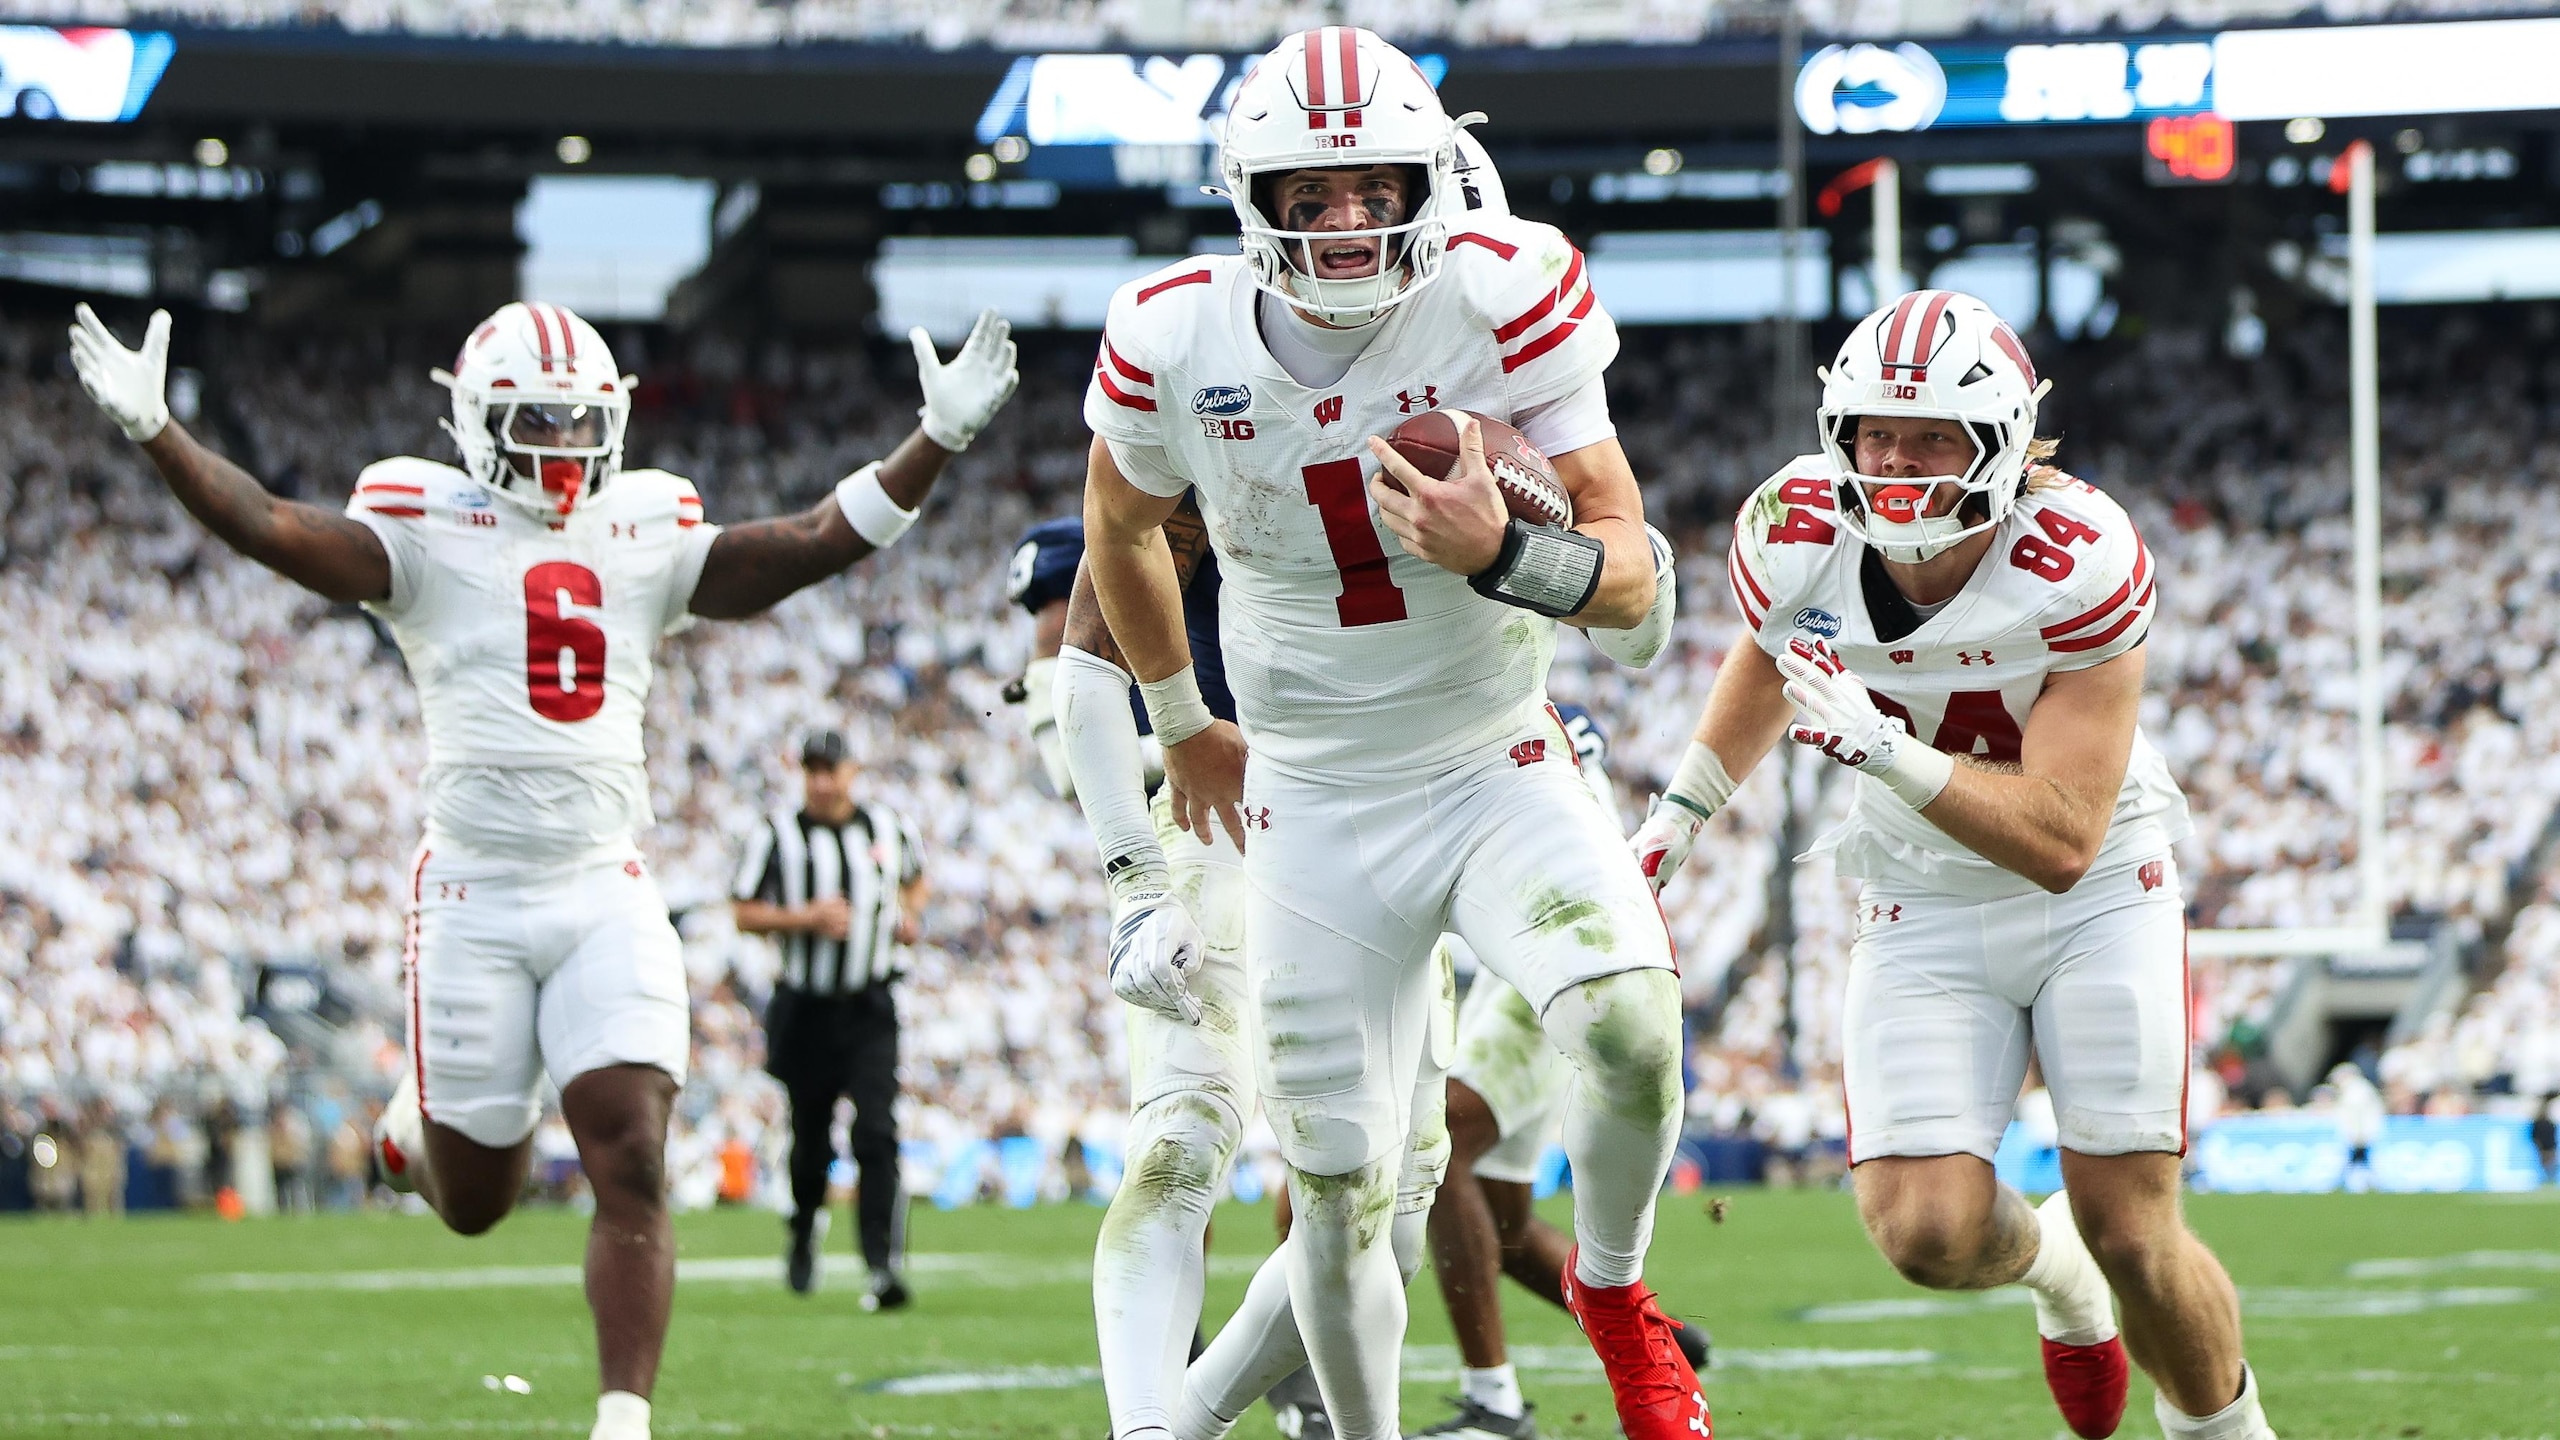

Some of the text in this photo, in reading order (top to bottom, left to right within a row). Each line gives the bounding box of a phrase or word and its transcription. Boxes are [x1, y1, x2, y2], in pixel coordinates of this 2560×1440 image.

[1191, 384, 1252, 414] Culver's
[1314, 395, 1343, 429] W
[1301, 456, 1409, 628] 1
[1766, 477, 1836, 546] 84
[2010, 507, 2102, 583] 84
[525, 562, 606, 722] 6
[1509, 739, 1546, 768] W
